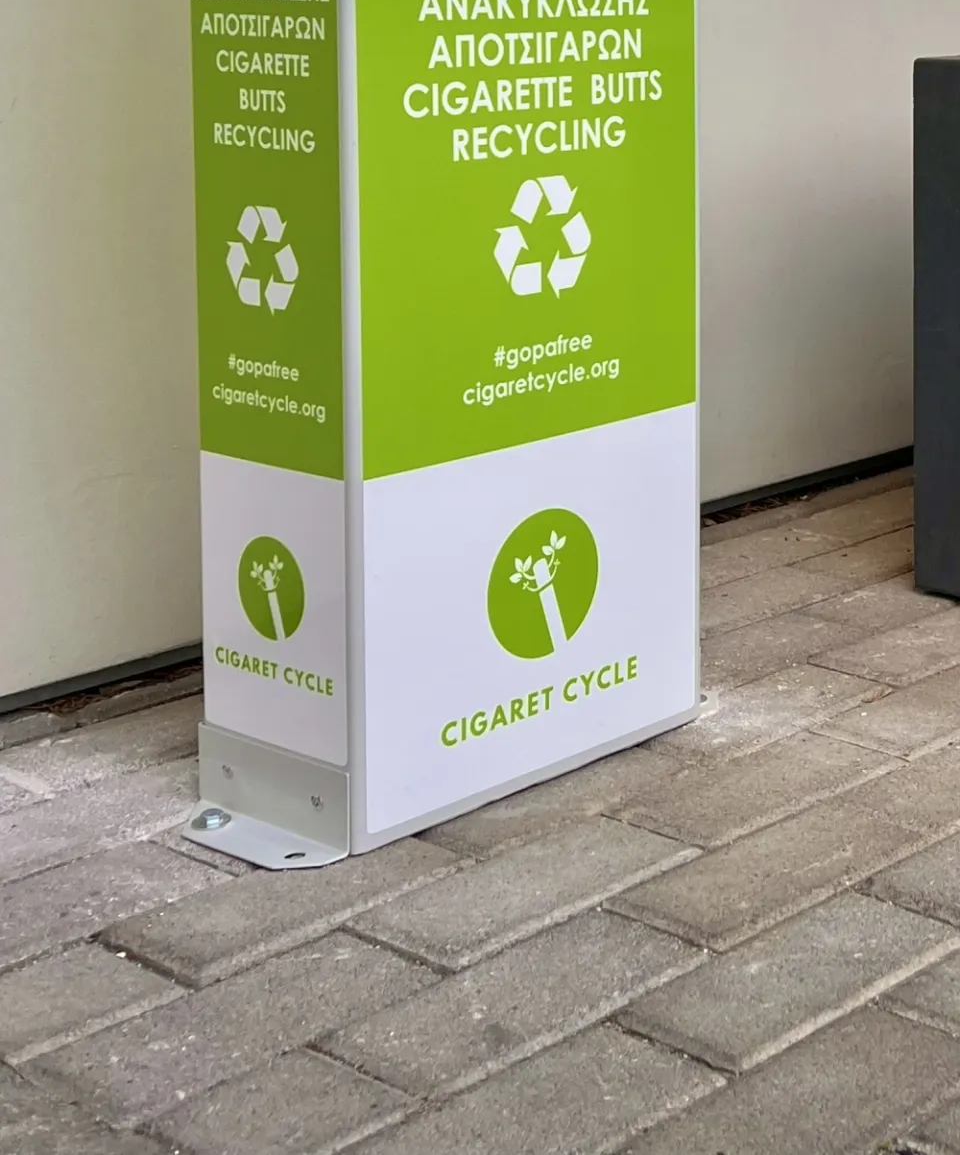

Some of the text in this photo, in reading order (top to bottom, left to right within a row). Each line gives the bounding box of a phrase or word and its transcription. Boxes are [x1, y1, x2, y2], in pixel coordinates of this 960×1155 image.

[201, 13, 324, 40] ΑΠΟΤΣΙΓΑΡΩΝ
[217, 50, 309, 77] CIGARETTE
[429, 29, 641, 68] ΑΠΟΤΣΙΓΑΡΩΝ
[240, 88, 285, 113] BUTTS
[404, 70, 662, 118] CIGARETTE BUTTS
[215, 123, 315, 153] RECYCLING
[452, 116, 626, 161] RECYCLING
[228, 353, 299, 381] #gopafree
[494, 334, 593, 368] #gopafree
[463, 357, 619, 405] cigaretcycle.org
[212, 383, 326, 423] cigaretcycle.org
[216, 647, 332, 696] CIGARET CYCLE
[441, 656, 637, 746] CIGARET CYCLE
